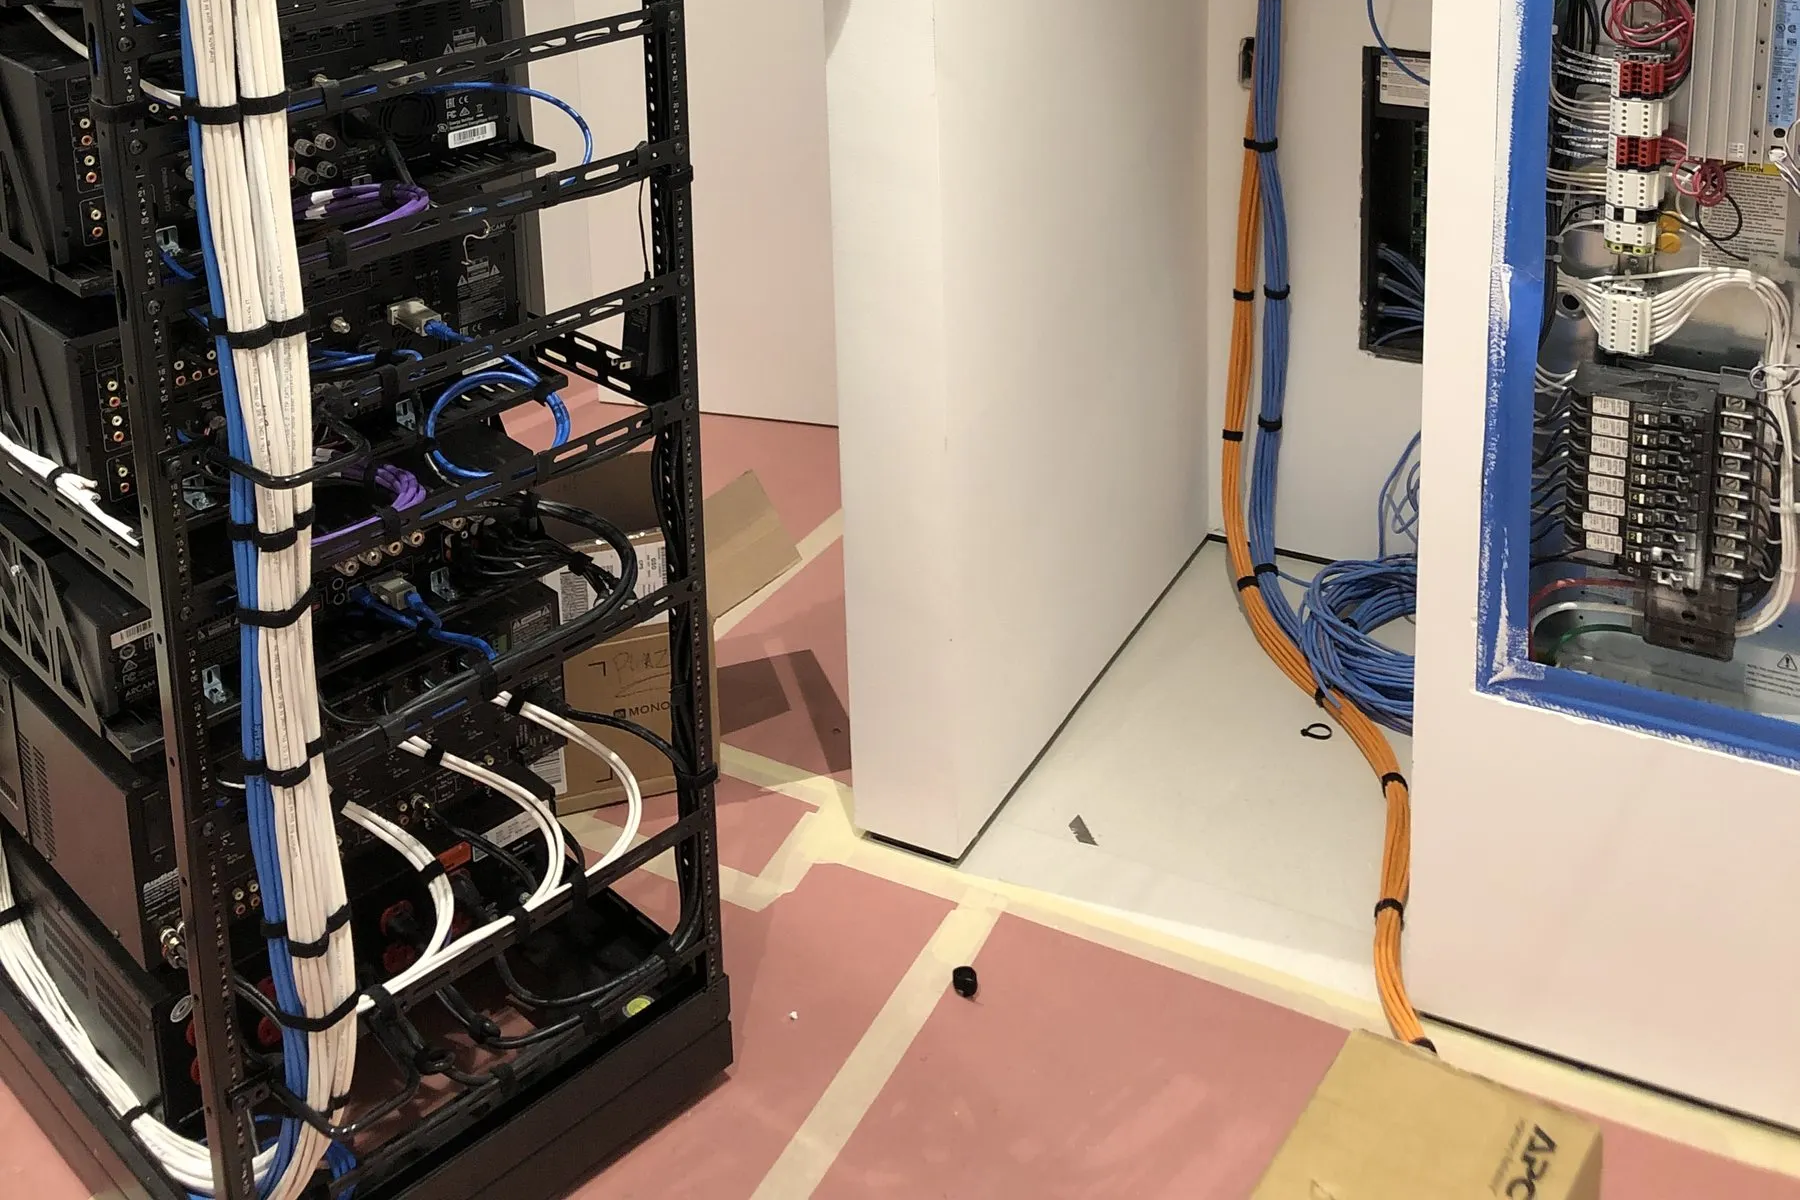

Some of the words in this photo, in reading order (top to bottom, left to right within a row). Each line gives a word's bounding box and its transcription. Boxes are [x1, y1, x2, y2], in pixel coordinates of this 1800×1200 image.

[116, 3, 126, 11] 24
[123, 66, 133, 74] 23
[138, 190, 147, 198] 21
[144, 250, 154, 258] 20
[126, 681, 156, 698] ARCAM
[1505, 1124, 1557, 1200] APC
